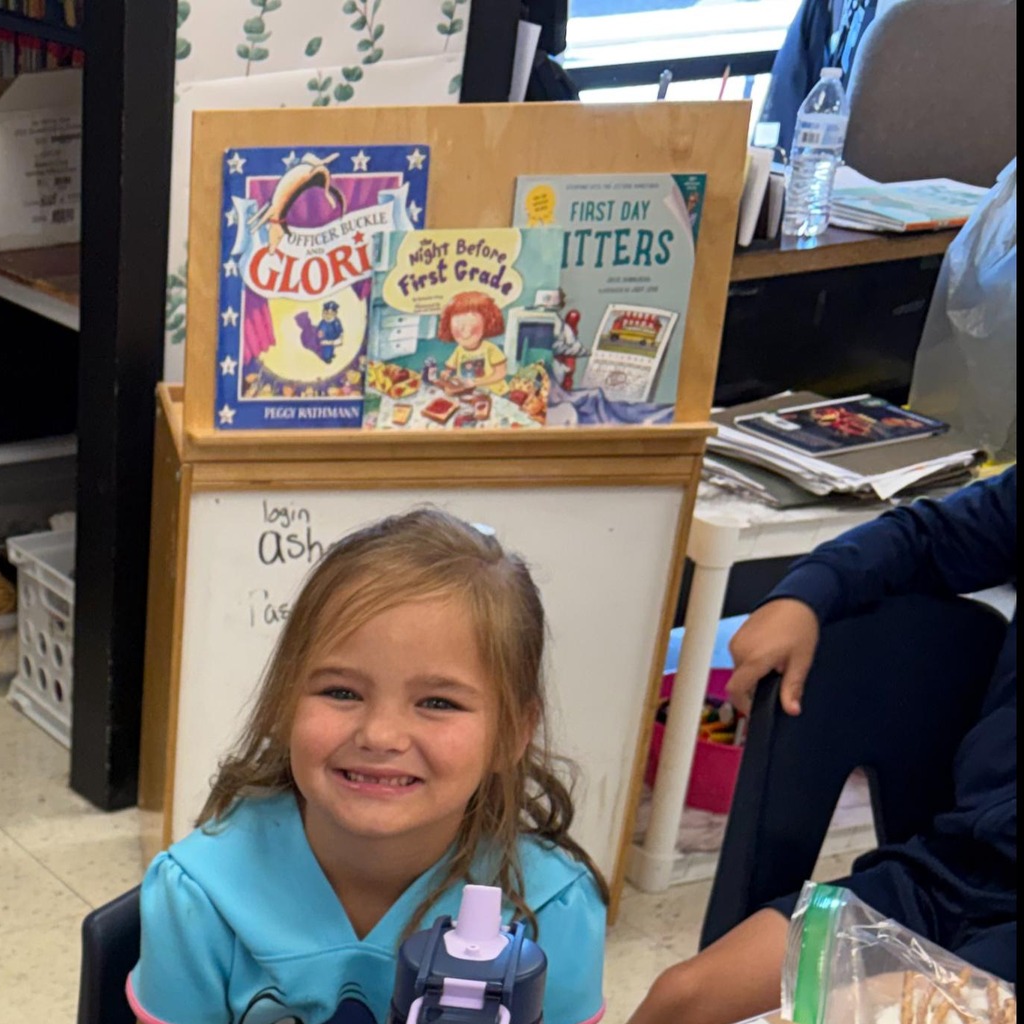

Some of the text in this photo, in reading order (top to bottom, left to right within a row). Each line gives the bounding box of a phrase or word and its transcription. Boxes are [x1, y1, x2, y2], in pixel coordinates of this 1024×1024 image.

[570, 200, 615, 222] FIRST
[620, 200, 651, 221] DAY
[287, 212, 388, 247] OFFICER BUCKLE
[456, 238, 507, 264] Before
[561, 228, 674, 269] ITTERS
[397, 258, 513, 297] First Grade
[263, 406, 361, 419] PEGGY RATHMANN
[262, 499, 310, 528] login
